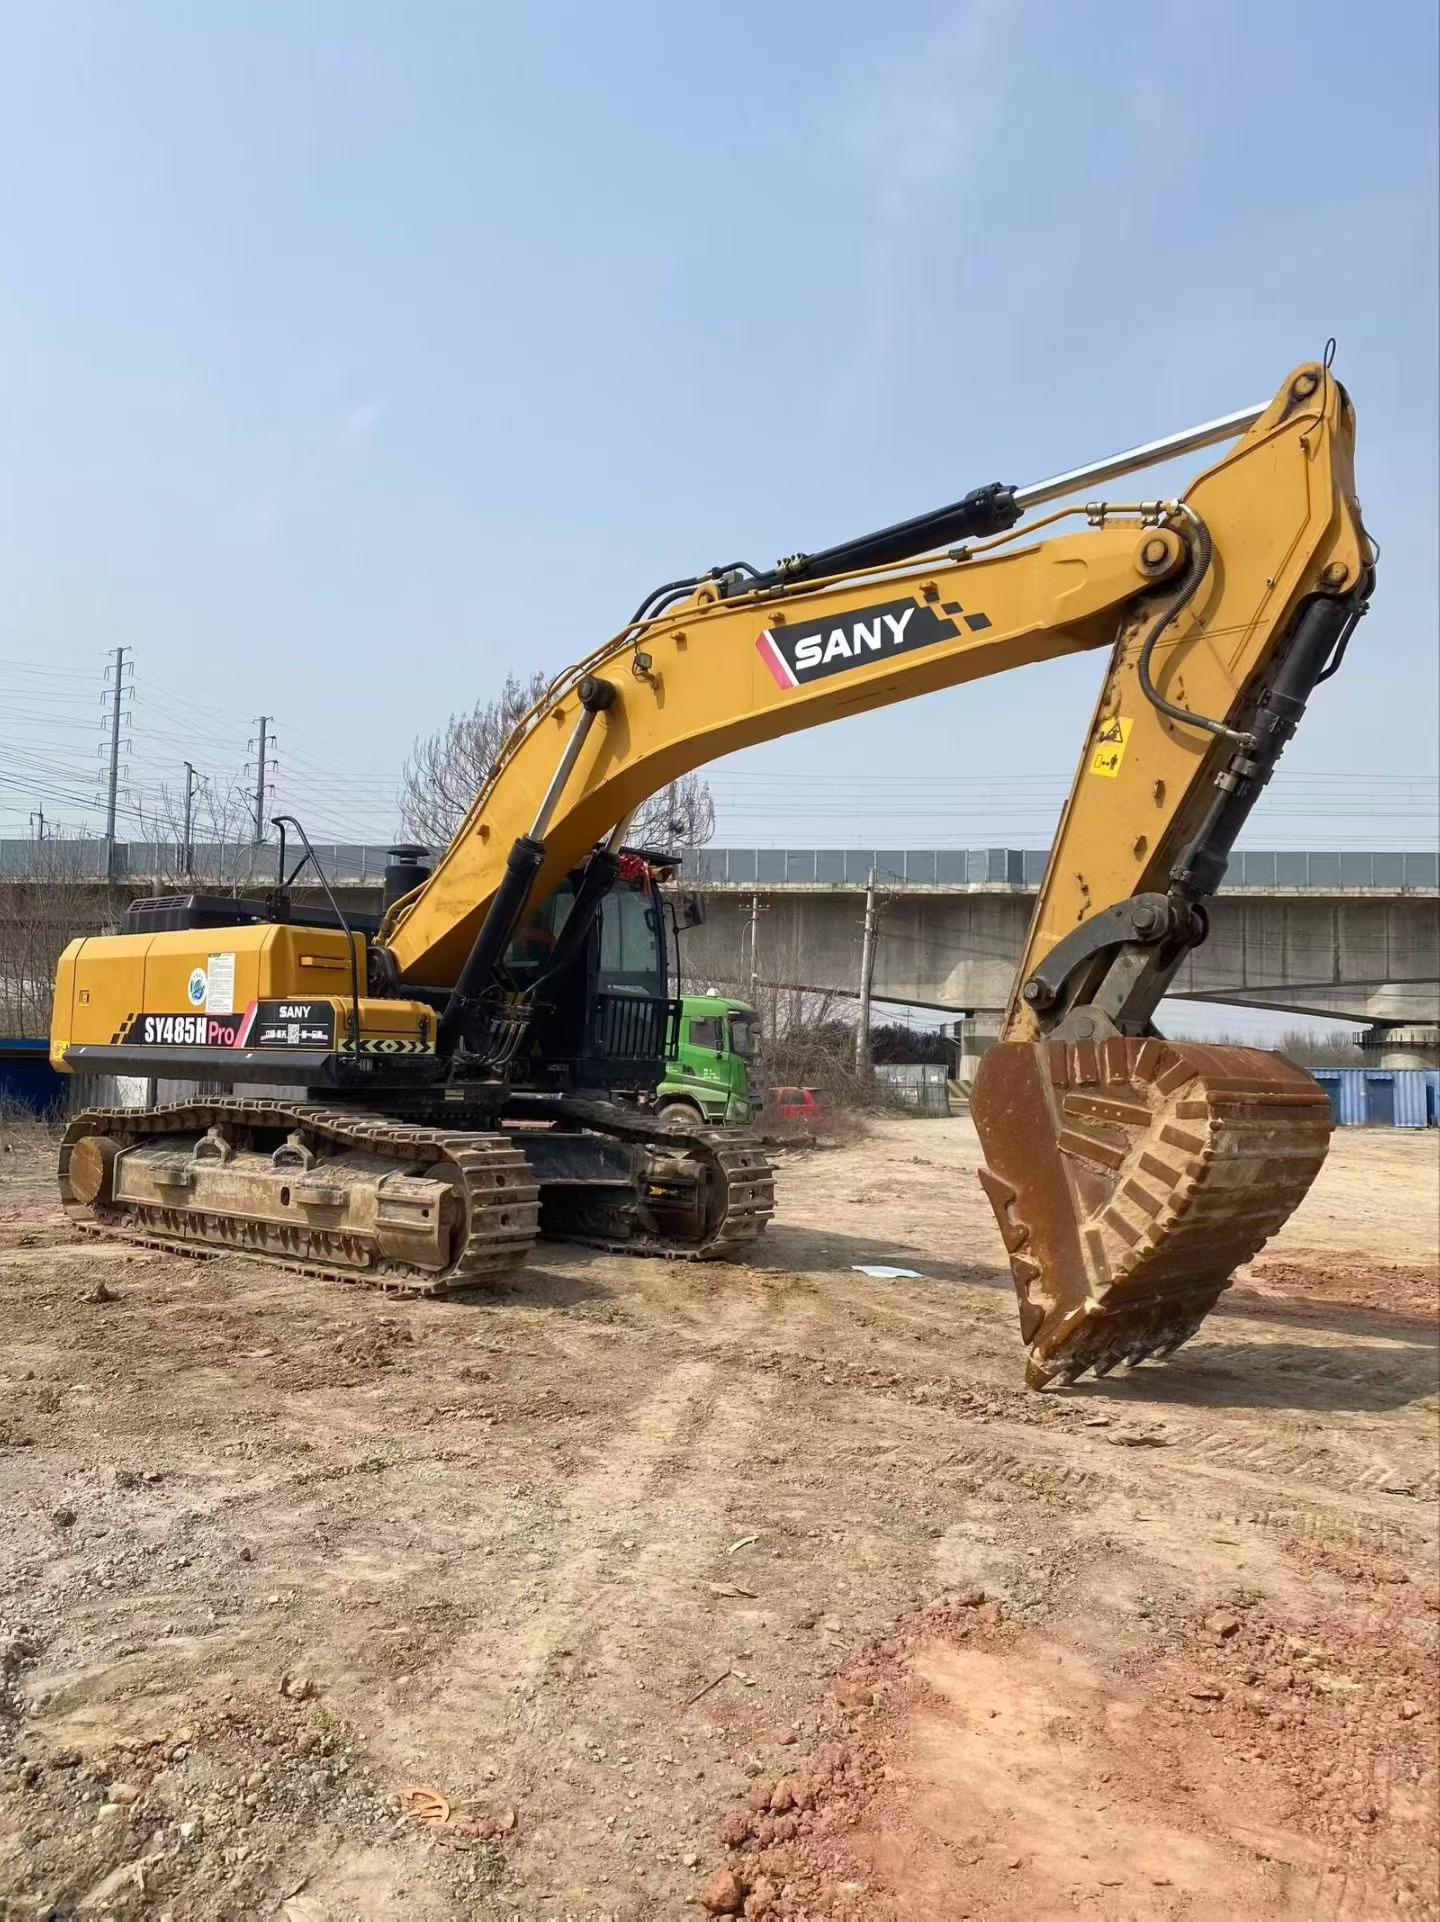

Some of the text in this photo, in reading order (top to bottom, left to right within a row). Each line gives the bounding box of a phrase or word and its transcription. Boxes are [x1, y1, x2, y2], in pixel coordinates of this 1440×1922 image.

[794, 607, 915, 671] SANY
[279, 1005, 311, 1018] SANY
[144, 1016, 235, 1045] SY485H Pro
